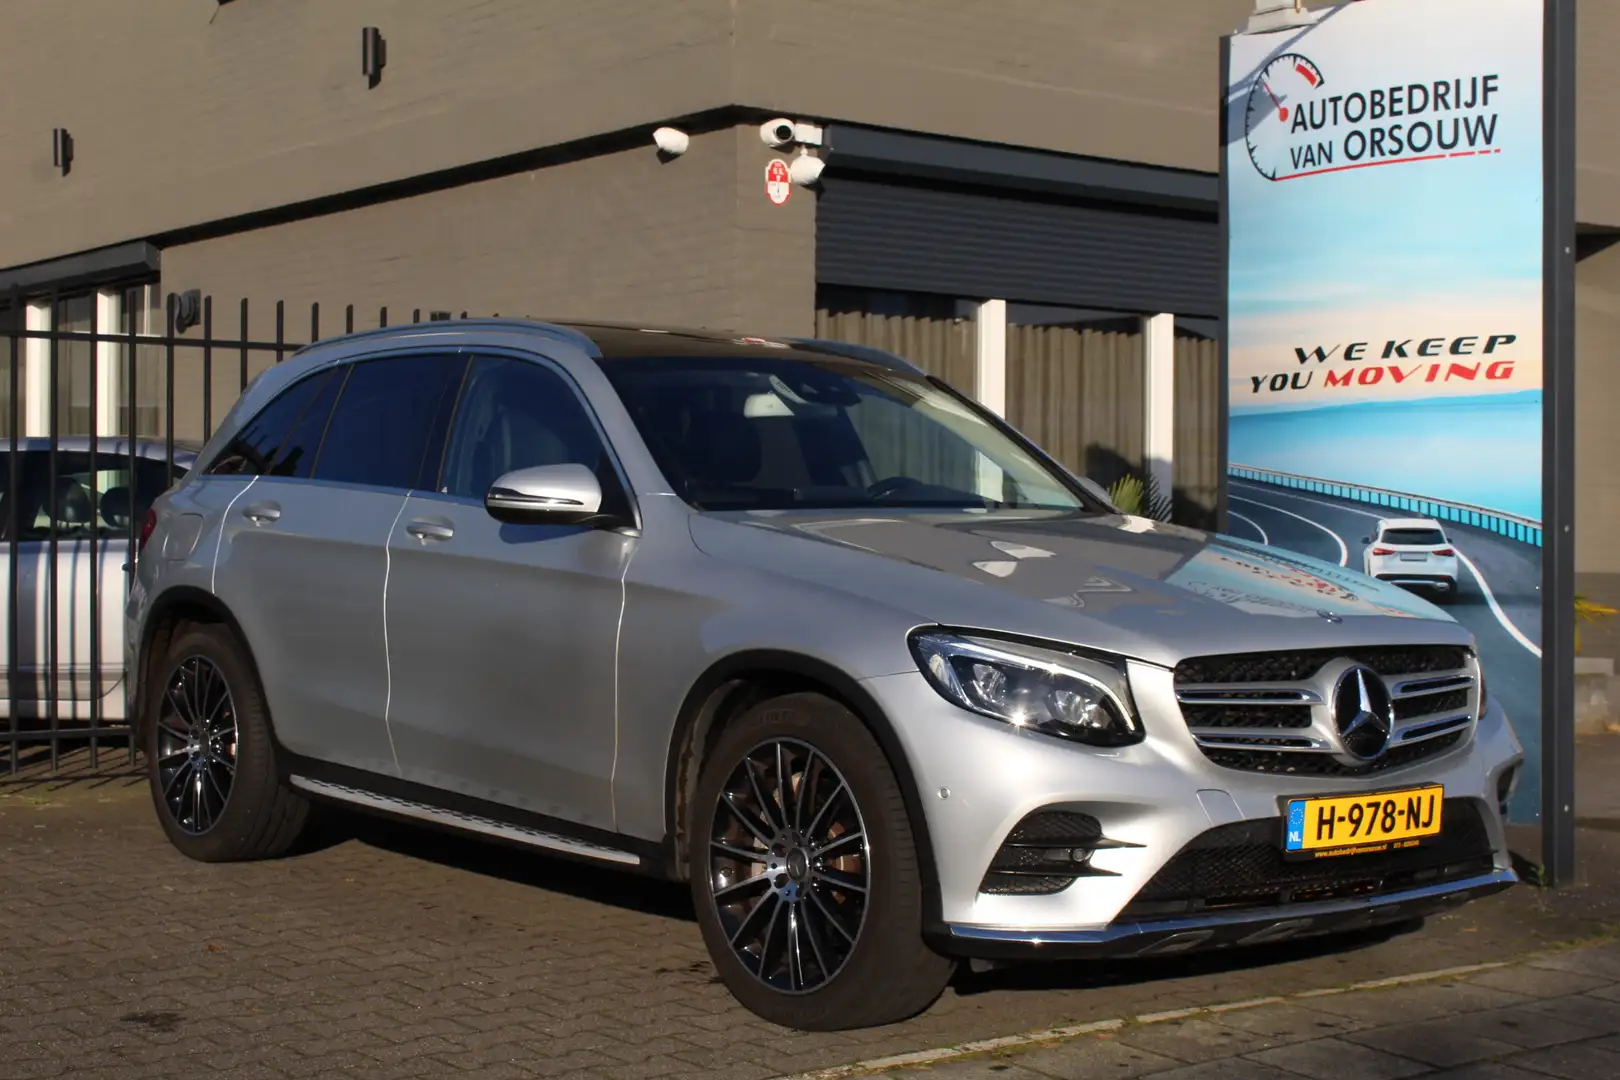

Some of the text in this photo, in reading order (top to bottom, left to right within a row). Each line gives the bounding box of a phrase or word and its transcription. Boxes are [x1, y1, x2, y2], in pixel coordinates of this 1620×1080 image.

[1291, 75, 1498, 134] AUTOBEDRIJF
[1290, 114, 1498, 170] VAN ORSOUW
[1294, 334, 1517, 365] WE KEEP
[1250, 360, 1516, 393] YOU MOVING
[1289, 832, 1301, 842] NL
[1317, 795, 1434, 840] H-978-NJ
